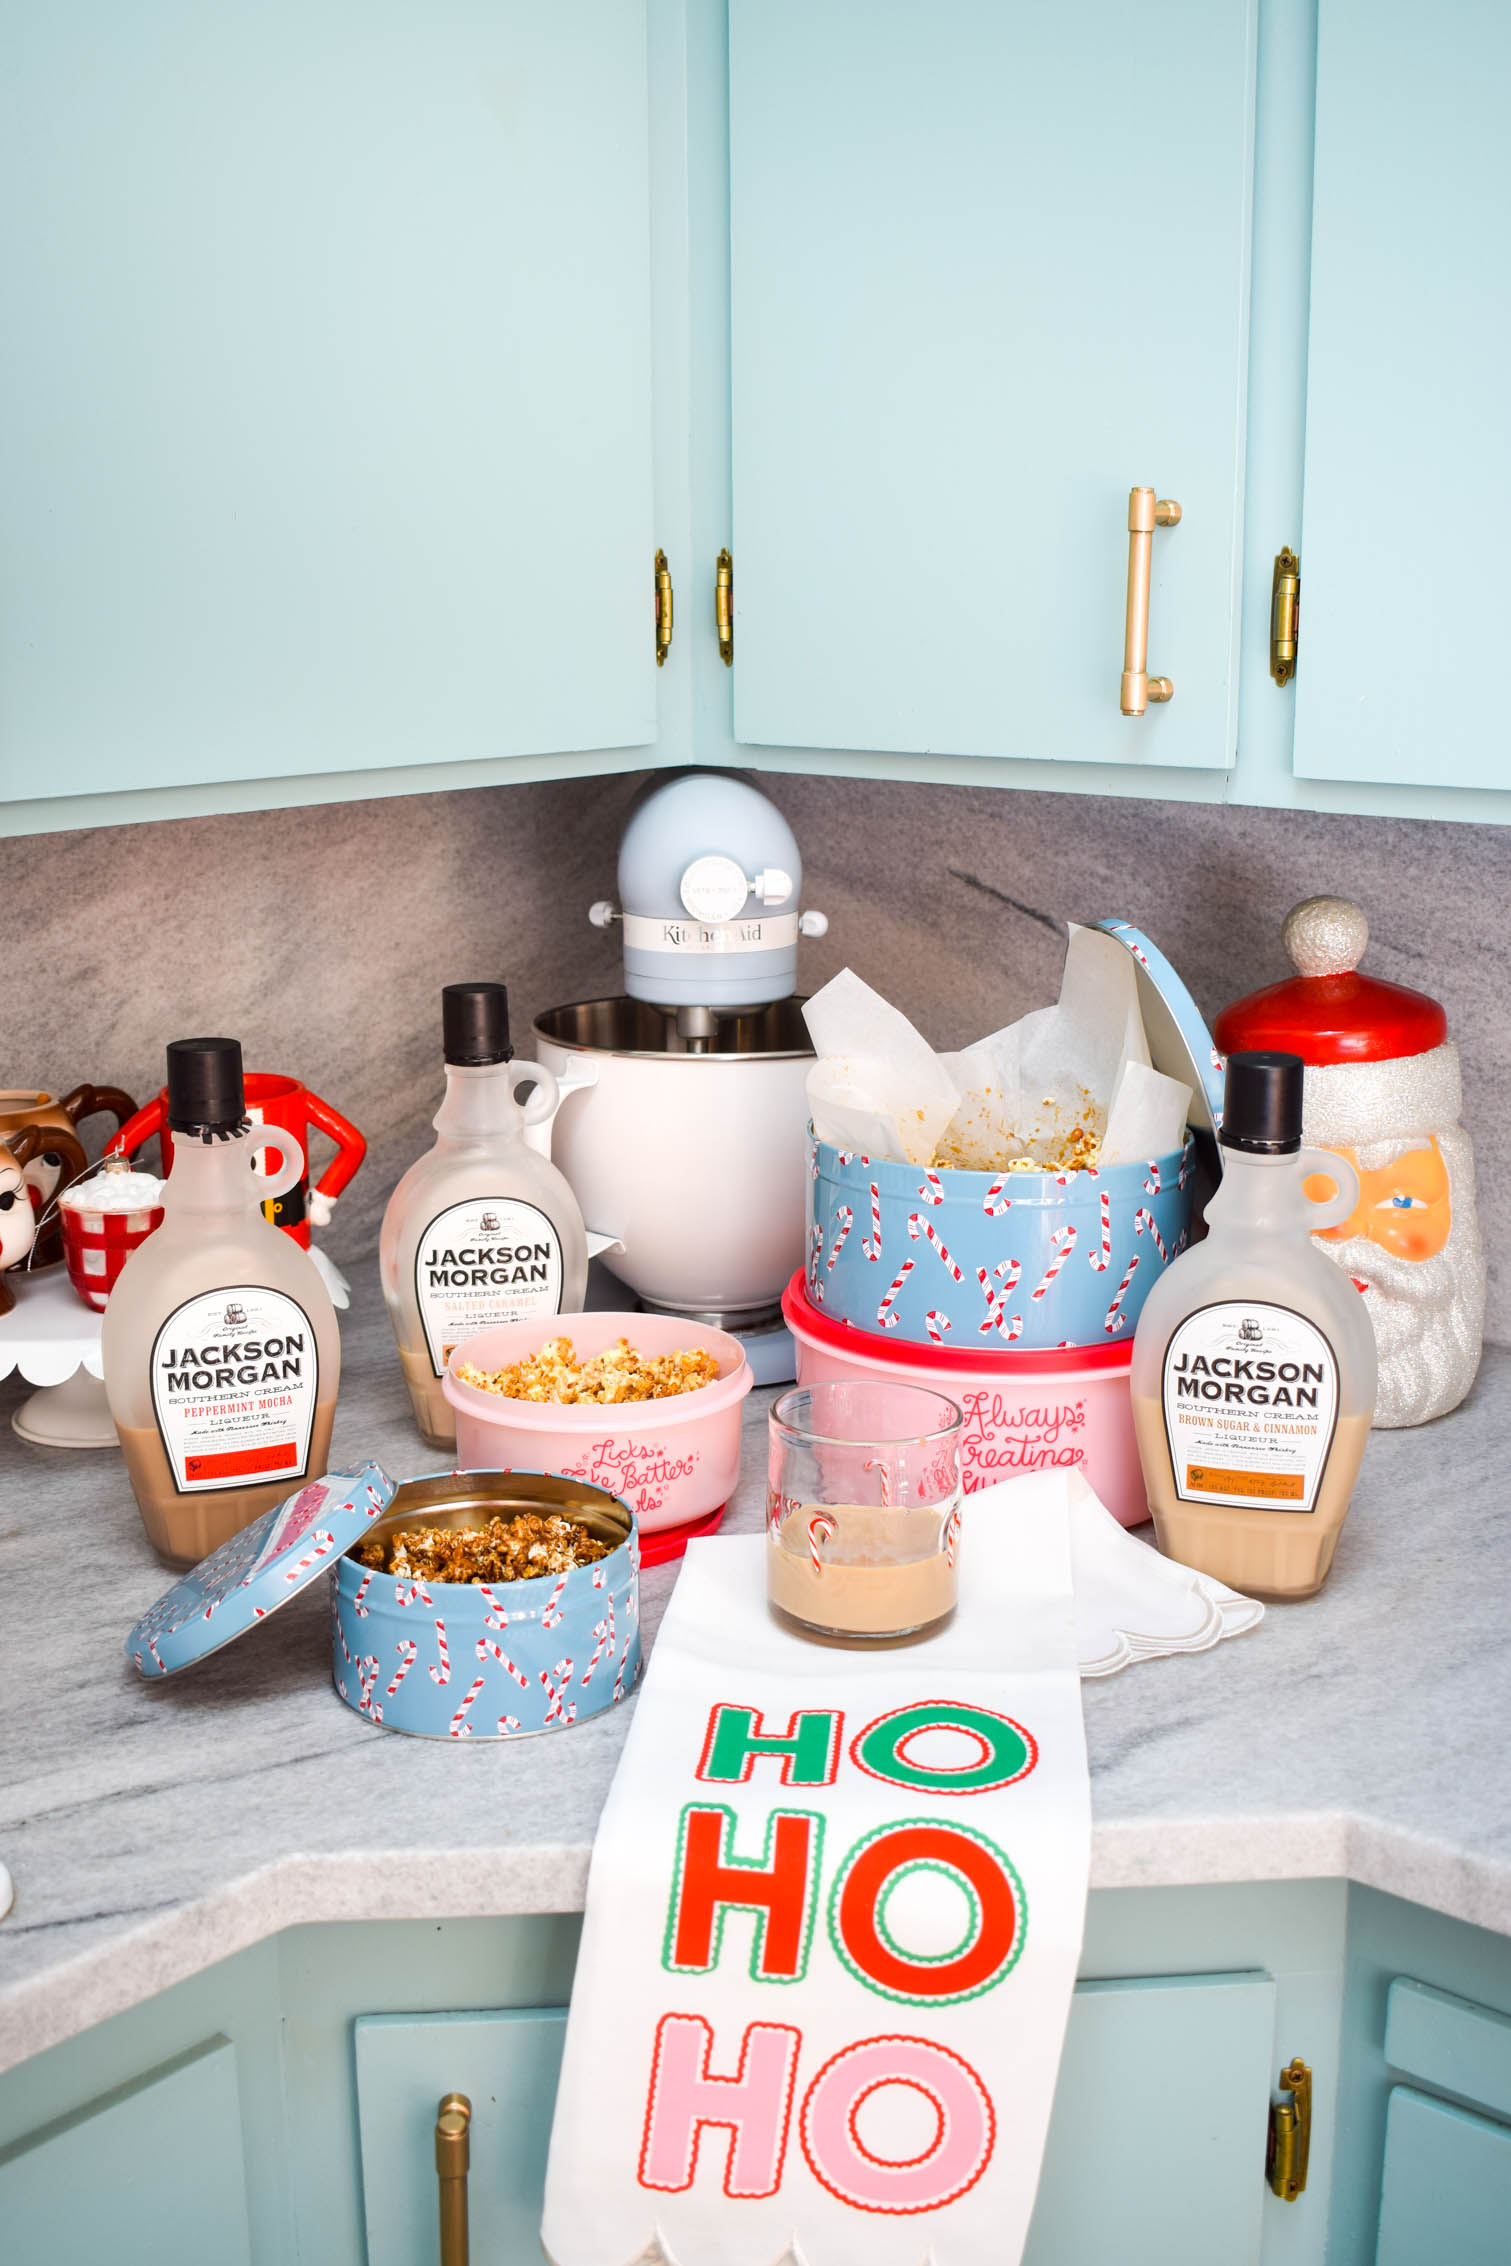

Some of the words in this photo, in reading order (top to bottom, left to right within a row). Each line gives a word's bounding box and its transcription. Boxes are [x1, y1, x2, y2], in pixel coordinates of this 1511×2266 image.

[663, 922, 763, 945] KitheAid
[425, 1242, 551, 1266] JACKSON
[430, 1263, 548, 1288] MORGAN
[430, 1290, 501, 1299] SOUTHERN
[505, 1286, 549, 1296] CREAM
[444, 1300, 485, 1312] SALTED
[488, 1296, 537, 1308] CARAMEL
[465, 1311, 518, 1319] LIQUEUR
[161, 1333, 304, 1369] JACKSON
[167, 1357, 302, 1393] MORGAN
[1173, 1353, 1324, 1383] JACKSON
[169, 1390, 250, 1405] SOUTHERN
[254, 1382, 304, 1396] CREAM
[1177, 1376, 1318, 1408] MORGAN
[184, 1401, 255, 1418] PEPPERMINT
[258, 1395, 293, 1409] MOCHA
[962, 1391, 1086, 1444] Always
[1176, 1402, 1260, 1418] SOUTHERN
[1263, 1412, 1319, 1421] CREAM
[210, 1413, 270, 1426] LIQUEUR
[1178, 1413, 1214, 1428] BROWN
[1216, 1420, 1250, 1432] SUGAR
[1252, 1424, 1261, 1433] &
[1263, 1424, 1318, 1435] CINNAMON
[1214, 1433, 1279, 1444] LIQUEUR
[612, 1459, 694, 1497] Batter
[695, 1698, 1040, 1796] HO
[660, 1801, 1029, 2008] HO
[636, 2012, 997, 2216] HO
